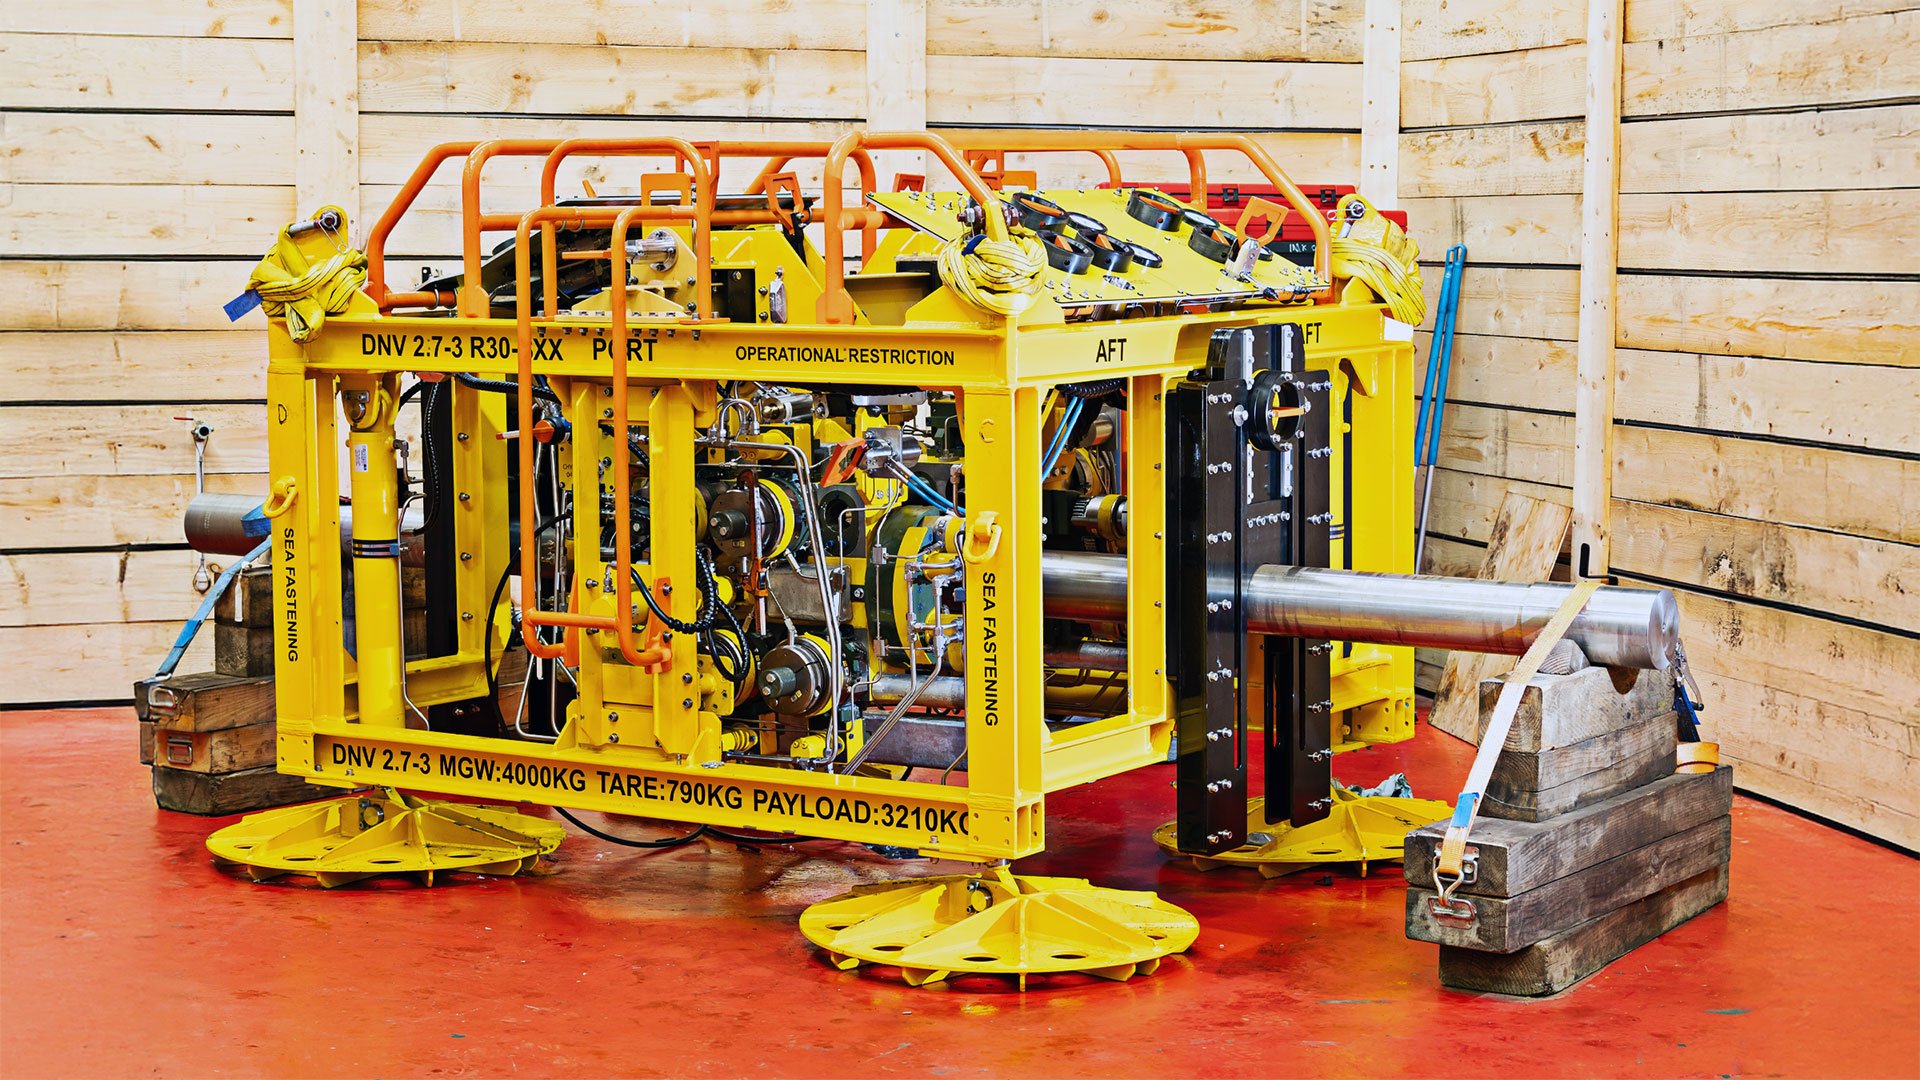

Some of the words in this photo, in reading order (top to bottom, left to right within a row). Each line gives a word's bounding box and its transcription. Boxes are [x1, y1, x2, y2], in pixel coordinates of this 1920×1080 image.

[361, 333, 407, 356] DNV
[470, 336, 564, 361] R30-XX
[592, 338, 658, 362] PRT
[735, 346, 845, 363] OPERATIONAL
[849, 348, 955, 366] RESTRICTION
[1095, 338, 1127, 363] AFT
[284, 527, 295, 562] SEA
[982, 571, 996, 612] SEA
[285, 566, 298, 662] FASTENING
[983, 616, 999, 727] FASTENING
[332, 743, 377, 768] DNV
[382, 748, 431, 774] 2.7-3
[439, 754, 586, 792] MGW:4000KG
[596, 770, 742, 809] TARE:790KG
